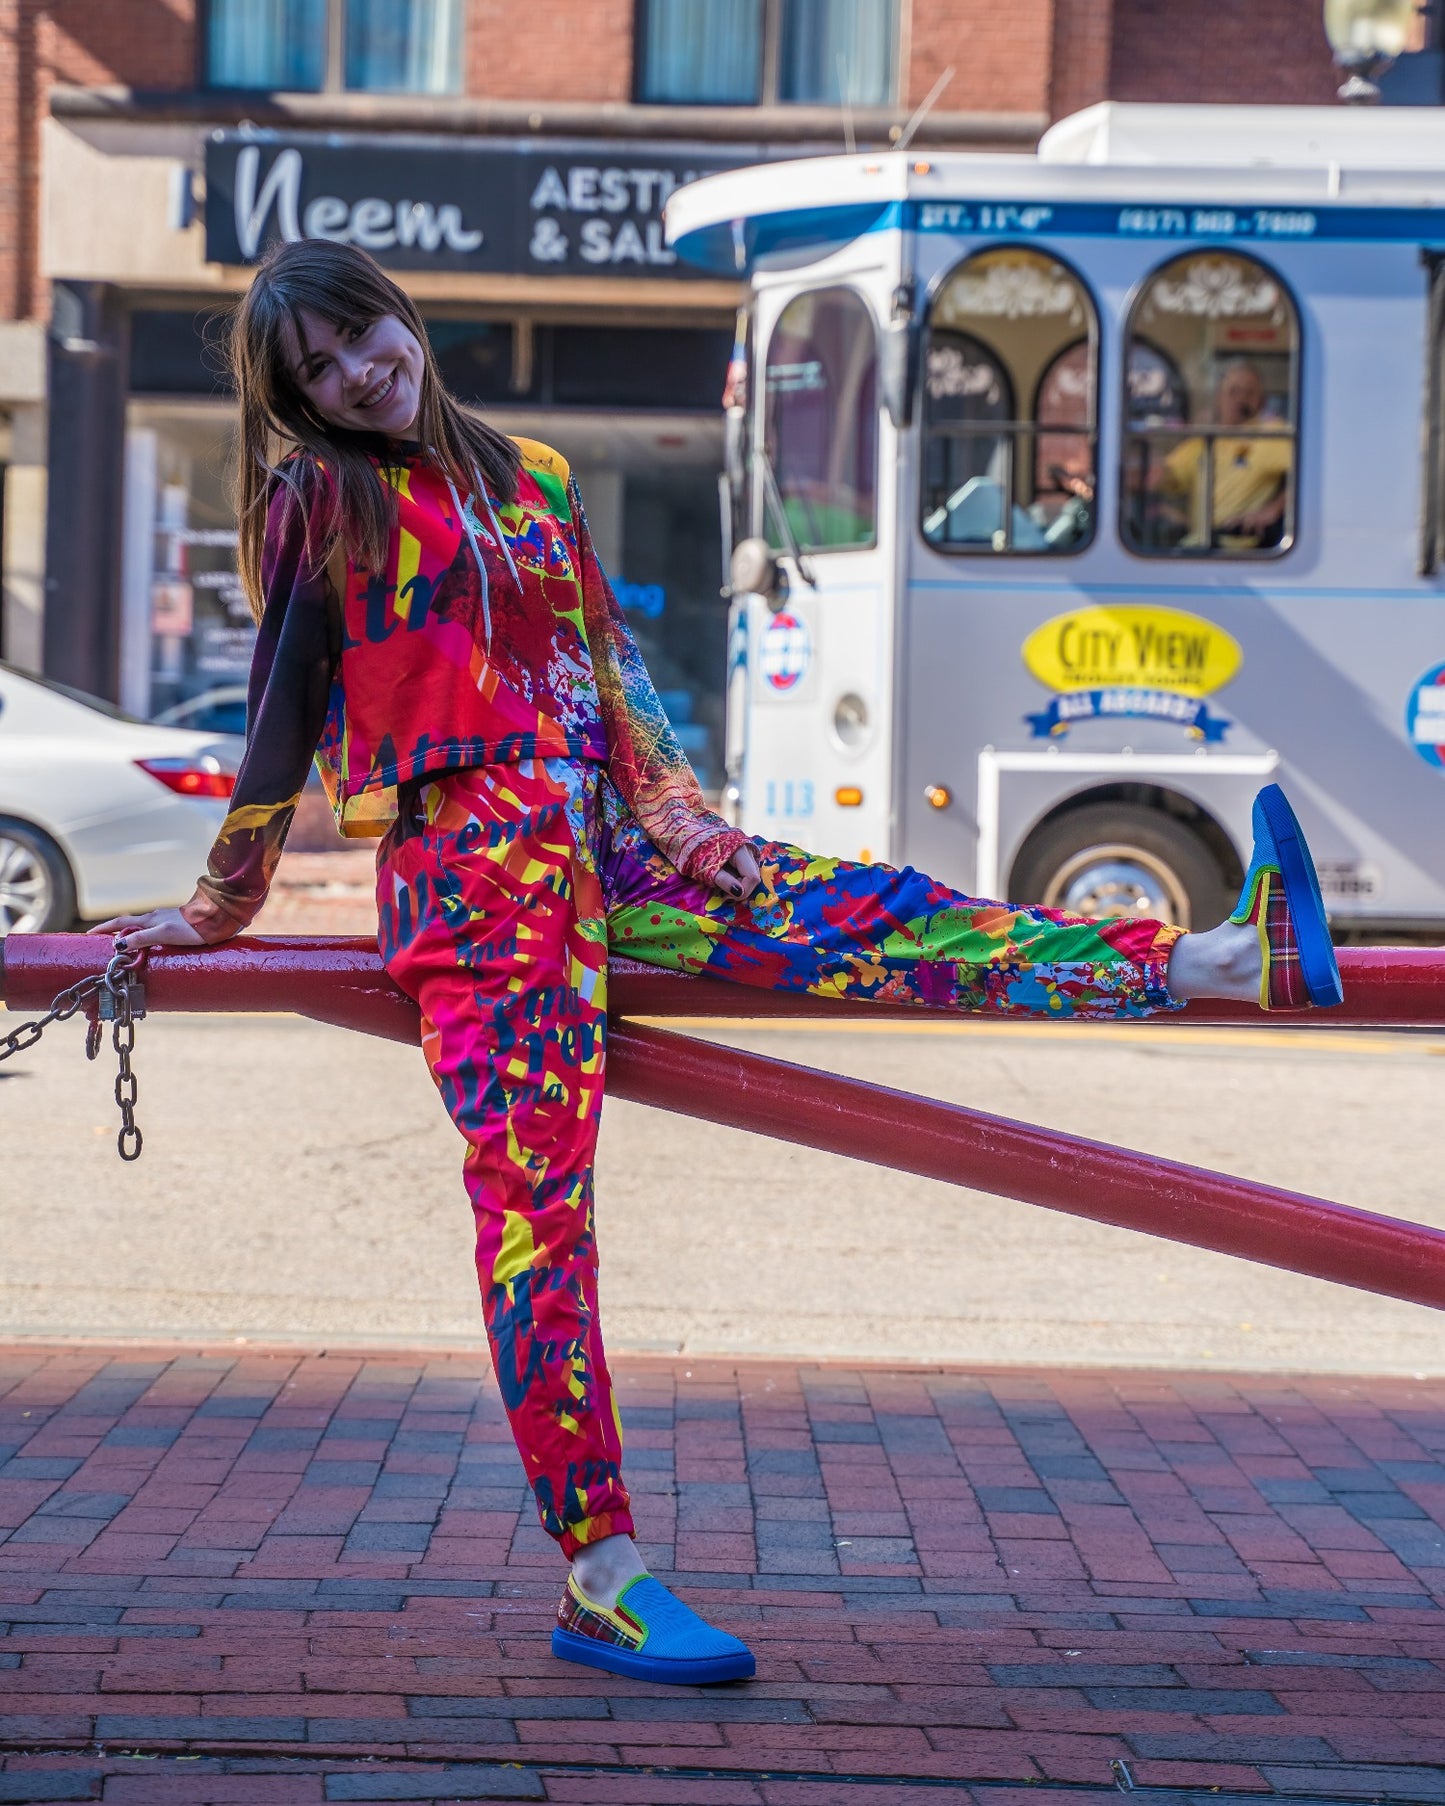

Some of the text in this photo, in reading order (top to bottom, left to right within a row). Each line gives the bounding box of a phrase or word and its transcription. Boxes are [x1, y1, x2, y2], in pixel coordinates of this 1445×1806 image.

[233, 145, 484, 258] Neem
[530, 166, 716, 213] AESTH
[529, 217, 568, 262] &
[766, 780, 815, 817] 113
